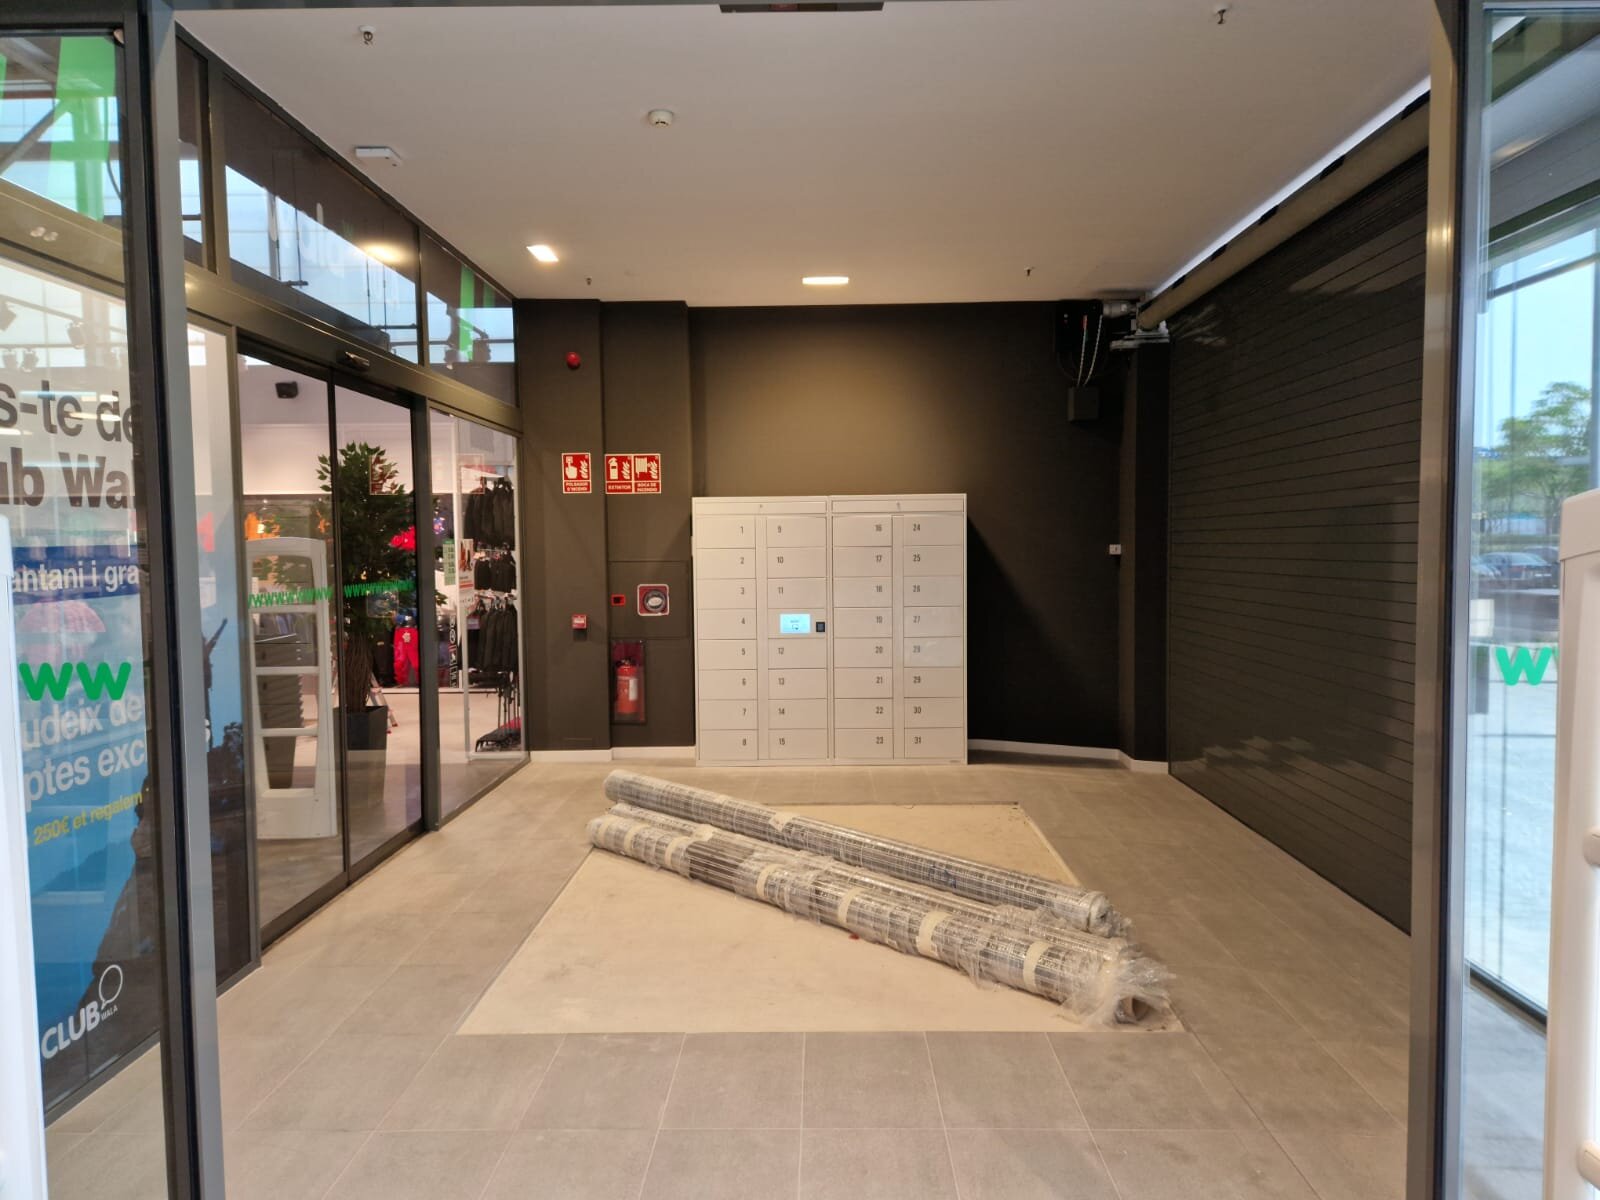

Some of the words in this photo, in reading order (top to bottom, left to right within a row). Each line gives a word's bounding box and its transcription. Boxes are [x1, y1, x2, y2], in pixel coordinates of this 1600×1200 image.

[874, 523, 883, 532] 16
[912, 523, 921, 532] 24
[777, 556, 784, 564] 10
[875, 554, 883, 563] 17
[912, 553, 921, 562] 25
[91, 560, 97, 587] i
[104, 564, 139, 592] gra
[777, 586, 784, 595] 11
[875, 585, 883, 593] 18
[912, 584, 921, 593] 26
[876, 615, 883, 624] 19
[912, 615, 921, 624] 27
[777, 647, 785, 655] 12
[875, 645, 884, 654] 20
[1495, 646, 1558, 686] w
[777, 677, 785, 686] 13
[875, 676, 884, 685] 21
[913, 675, 922, 684] 29
[778, 707, 786, 715] 14
[875, 706, 884, 715] 22
[913, 706, 922, 715] 30
[778, 737, 786, 746] 15
[875, 735, 884, 745] 23
[914, 736, 922, 745] 31
[33, 815, 70, 846] 250€
[73, 812, 87, 829] et
[41, 1000, 101, 1060] CLUB
[101, 1004, 119, 1021] WALA
